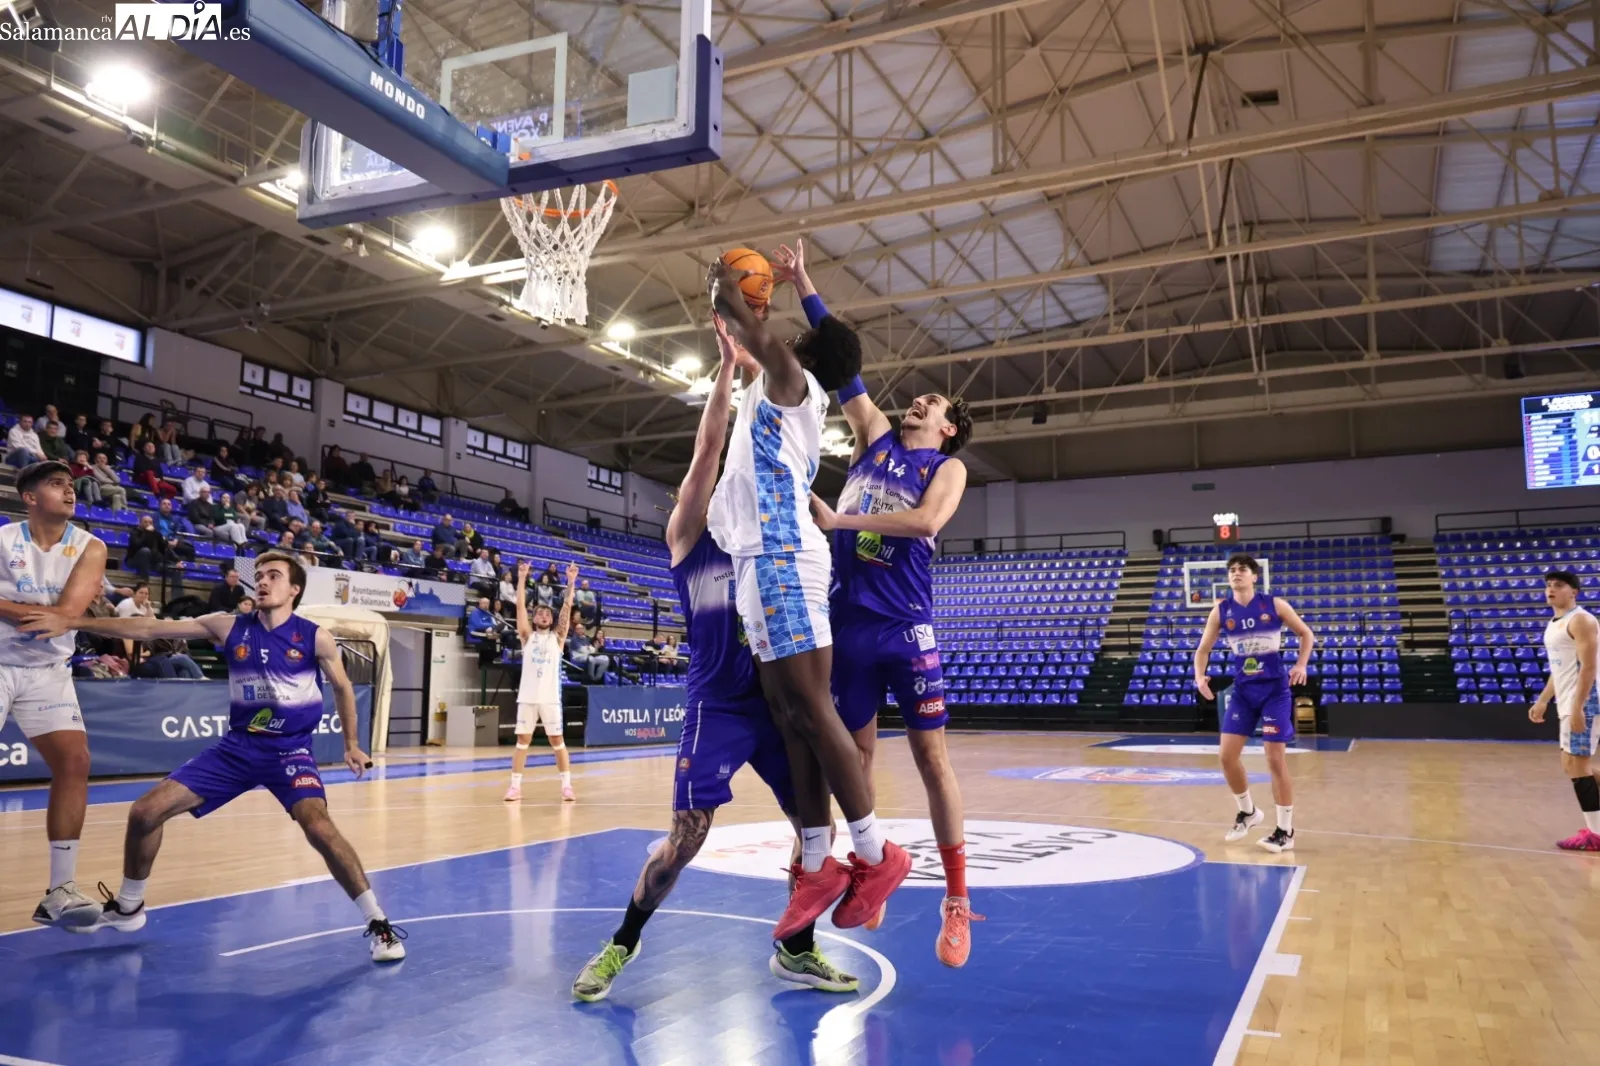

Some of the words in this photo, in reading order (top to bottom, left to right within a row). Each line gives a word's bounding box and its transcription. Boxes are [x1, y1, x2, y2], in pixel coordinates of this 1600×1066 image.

[370, 71, 425, 120] MONDO
[888, 458, 907, 478] 14
[886, 488, 917, 508] Compost
[1219, 525, 1231, 539] 8
[713, 570, 736, 582] Instit
[352, 585, 392, 597] Ayuntamiento
[351, 596, 359, 605] de
[360, 596, 391, 607] Salamanca
[1241, 617, 1256, 630] 10
[903, 625, 934, 643] USC
[260, 648, 270, 664] 5
[602, 708, 650, 724] CASTILLA
[161, 715, 232, 739] CAST
